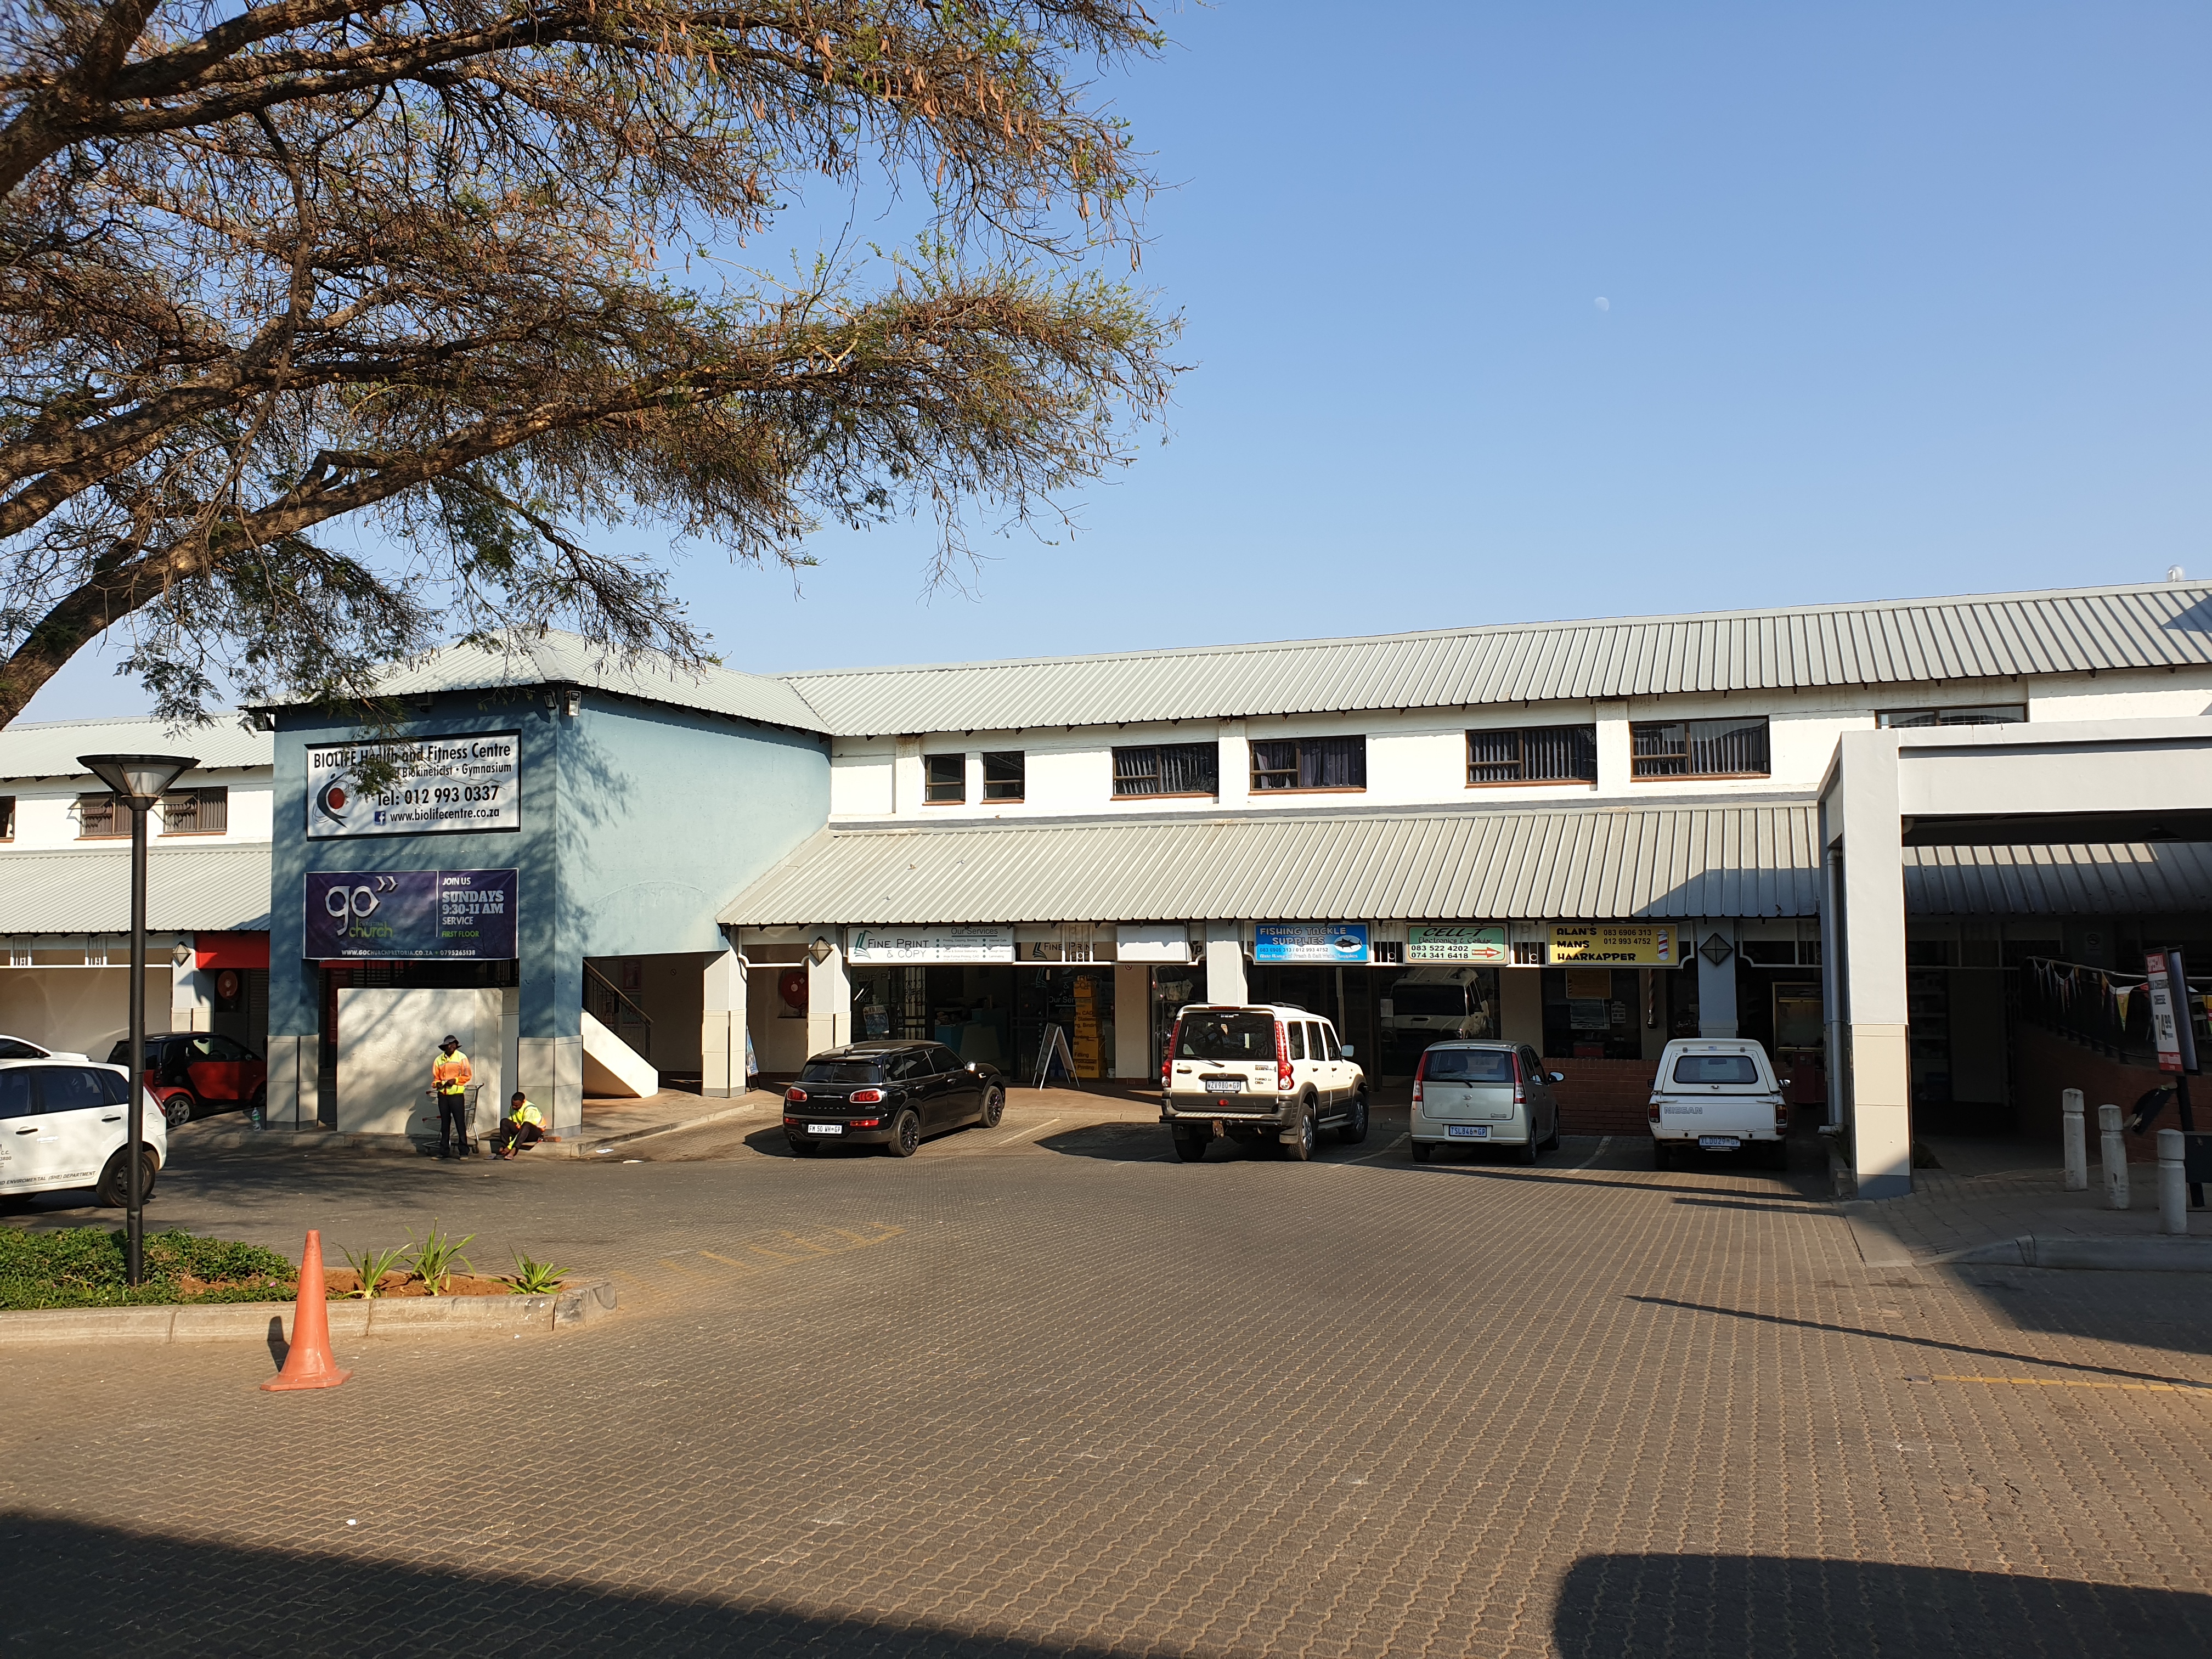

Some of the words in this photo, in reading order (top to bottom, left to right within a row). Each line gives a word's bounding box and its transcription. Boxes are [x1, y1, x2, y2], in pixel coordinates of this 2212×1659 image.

[314, 751, 356, 768] BIOLIFE
[428, 744, 467, 761] Fitness
[472, 742, 511, 758] Centre
[462, 762, 511, 777] Gymnasium
[377, 790, 399, 806] Tel:
[405, 788, 429, 804] 012
[435, 787, 459, 803] 993
[465, 785, 499, 802] 0337
[390, 807, 500, 822] www.biolifecentre.co.za
[443, 877, 459, 886] JOIN
[461, 877, 471, 885] US
[442, 890, 504, 903] SUNDAYS
[325, 885, 380, 936] go
[442, 904, 480, 915] 9:30-11
[482, 903, 504, 914] AM
[442, 916, 473, 925] SERVICE
[349, 917, 393, 938] church
[1260, 927, 1302, 935] FISHING
[1306, 927, 1346, 935] TACKLE
[1423, 928, 1488, 936] CELL-T
[1556, 927, 1597, 935] ALAN'S
[868, 939, 891, 948] FINE
[896, 939, 929, 948] PRINT
[1272, 936, 1325, 945] SUPPLIES
[1044, 942, 1062, 950] FINE
[1069, 942, 1097, 950] PRNT
[887, 950, 894, 958] &
[898, 950, 927, 958] COPY
[1451, 1127, 1473, 1135] TSL846
[63, 1171, 96, 1179] DEPARTMENT
